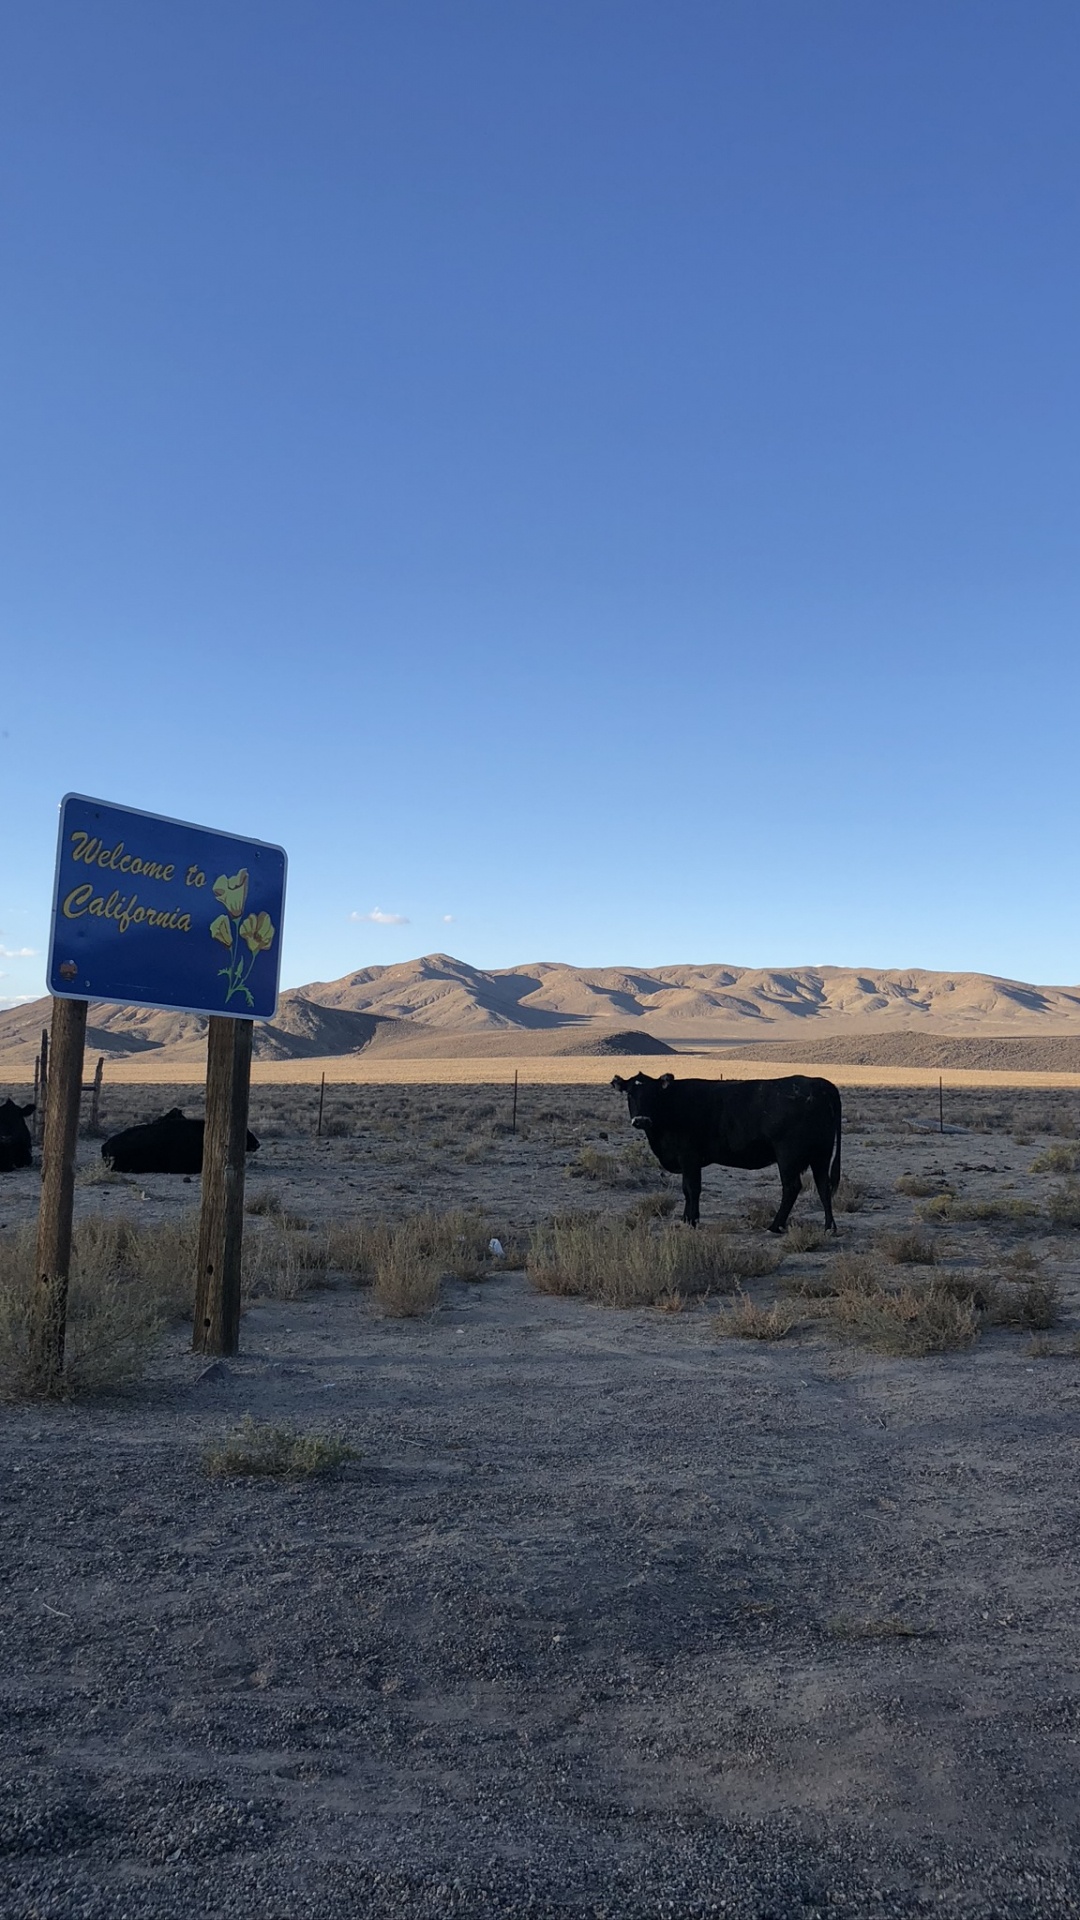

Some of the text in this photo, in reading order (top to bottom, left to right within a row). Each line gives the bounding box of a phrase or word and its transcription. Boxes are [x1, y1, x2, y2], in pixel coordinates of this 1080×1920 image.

[71, 832, 206, 888] Welcome to
[63, 885, 192, 933] California
